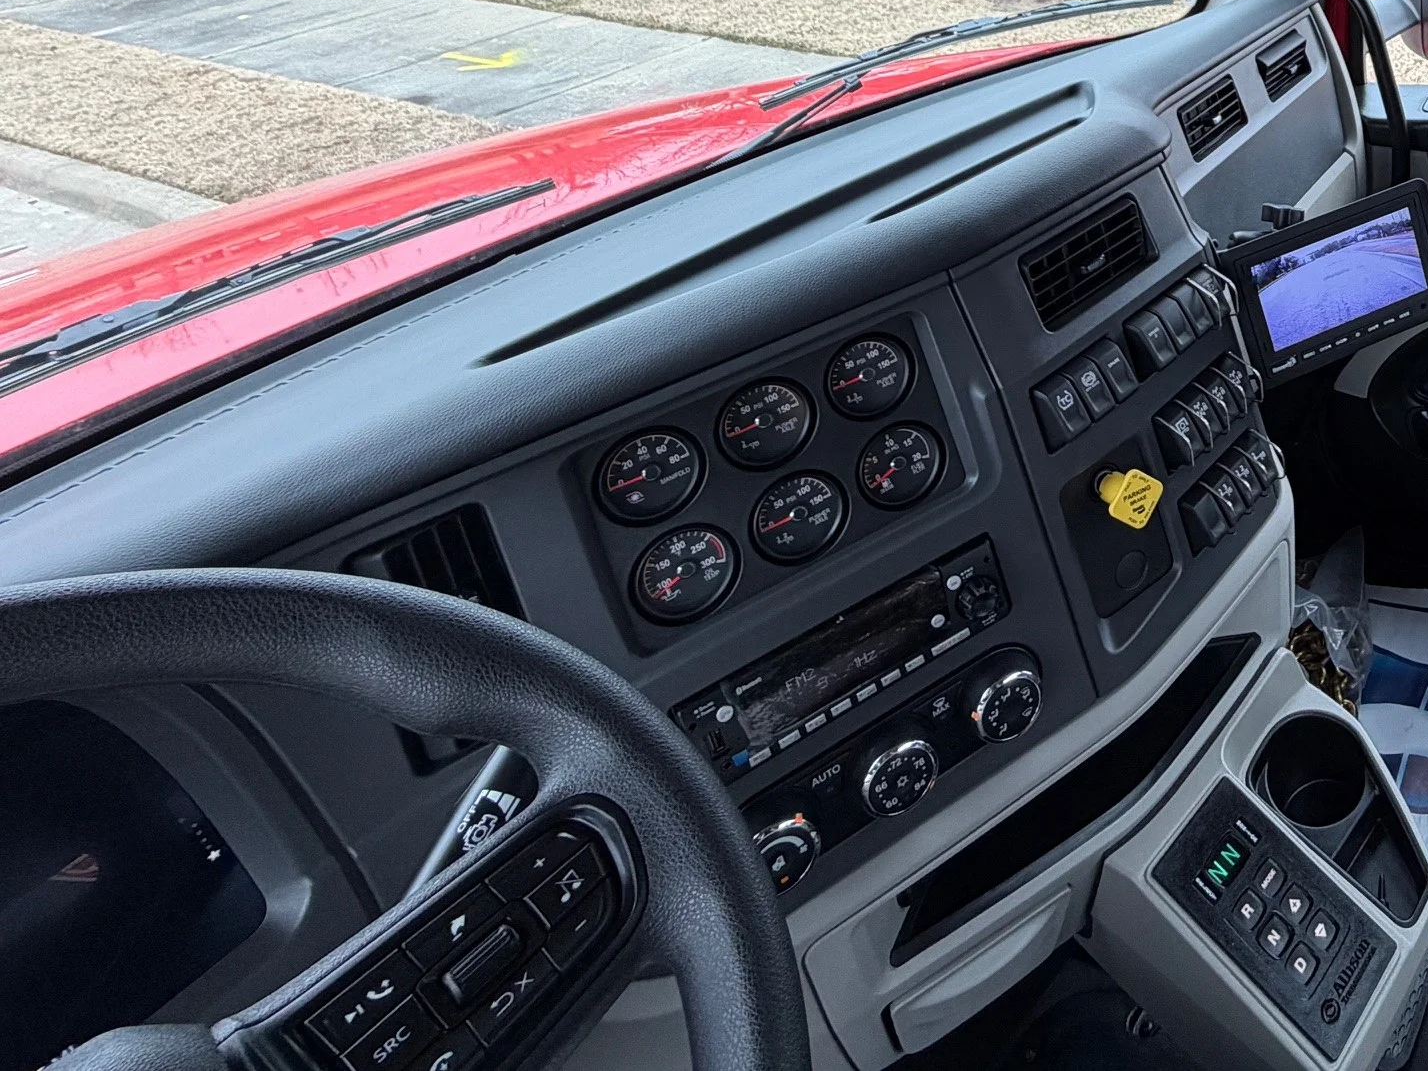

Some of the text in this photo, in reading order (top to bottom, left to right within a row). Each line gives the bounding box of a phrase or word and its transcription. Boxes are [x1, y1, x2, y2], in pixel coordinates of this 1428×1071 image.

[866, 349, 879, 359] 100
[845, 360, 855, 369] 50
[877, 359, 890, 370] 150
[764, 393, 779, 404] 100
[740, 405, 751, 415] 50
[777, 403, 791, 414] 150
[885, 439, 895, 447] 10
[903, 438, 913, 447] 15
[637, 446, 648, 455] 40
[655, 444, 667, 454] 60
[669, 454, 680, 464] 80
[872, 456, 879, 464] 5
[912, 452, 922, 461] 20
[622, 459, 633, 470] 20
[660, 467, 691, 485] MANIFOLD
[796, 485, 811, 496] 100
[1123, 484, 1152, 503] PARKING
[773, 499, 784, 509] 50
[809, 494, 823, 506] 150
[1130, 494, 1147, 506] BRAKE
[670, 540, 686, 554] 200
[690, 541, 706, 554] 250
[655, 559, 670, 571] 150
[700, 556, 716, 569] 300
[656, 578, 673, 590] 100
[932, 702, 950, 717] MAX
[890, 758, 902, 770] 72
[913, 757, 925, 769] 78
[811, 764, 841, 788] AUTO
[875, 781, 888, 793] 66
[914, 779, 926, 791] 84
[885, 797, 898, 808] 60
[457, 805, 477, 834] OFF
[1261, 868, 1277, 889] MODE
[1241, 903, 1255, 919] R
[1267, 929, 1281, 946] N
[1293, 957, 1307, 974] D
[1333, 939, 1371, 999] Allison
[373, 1025, 411, 1063] SRC
